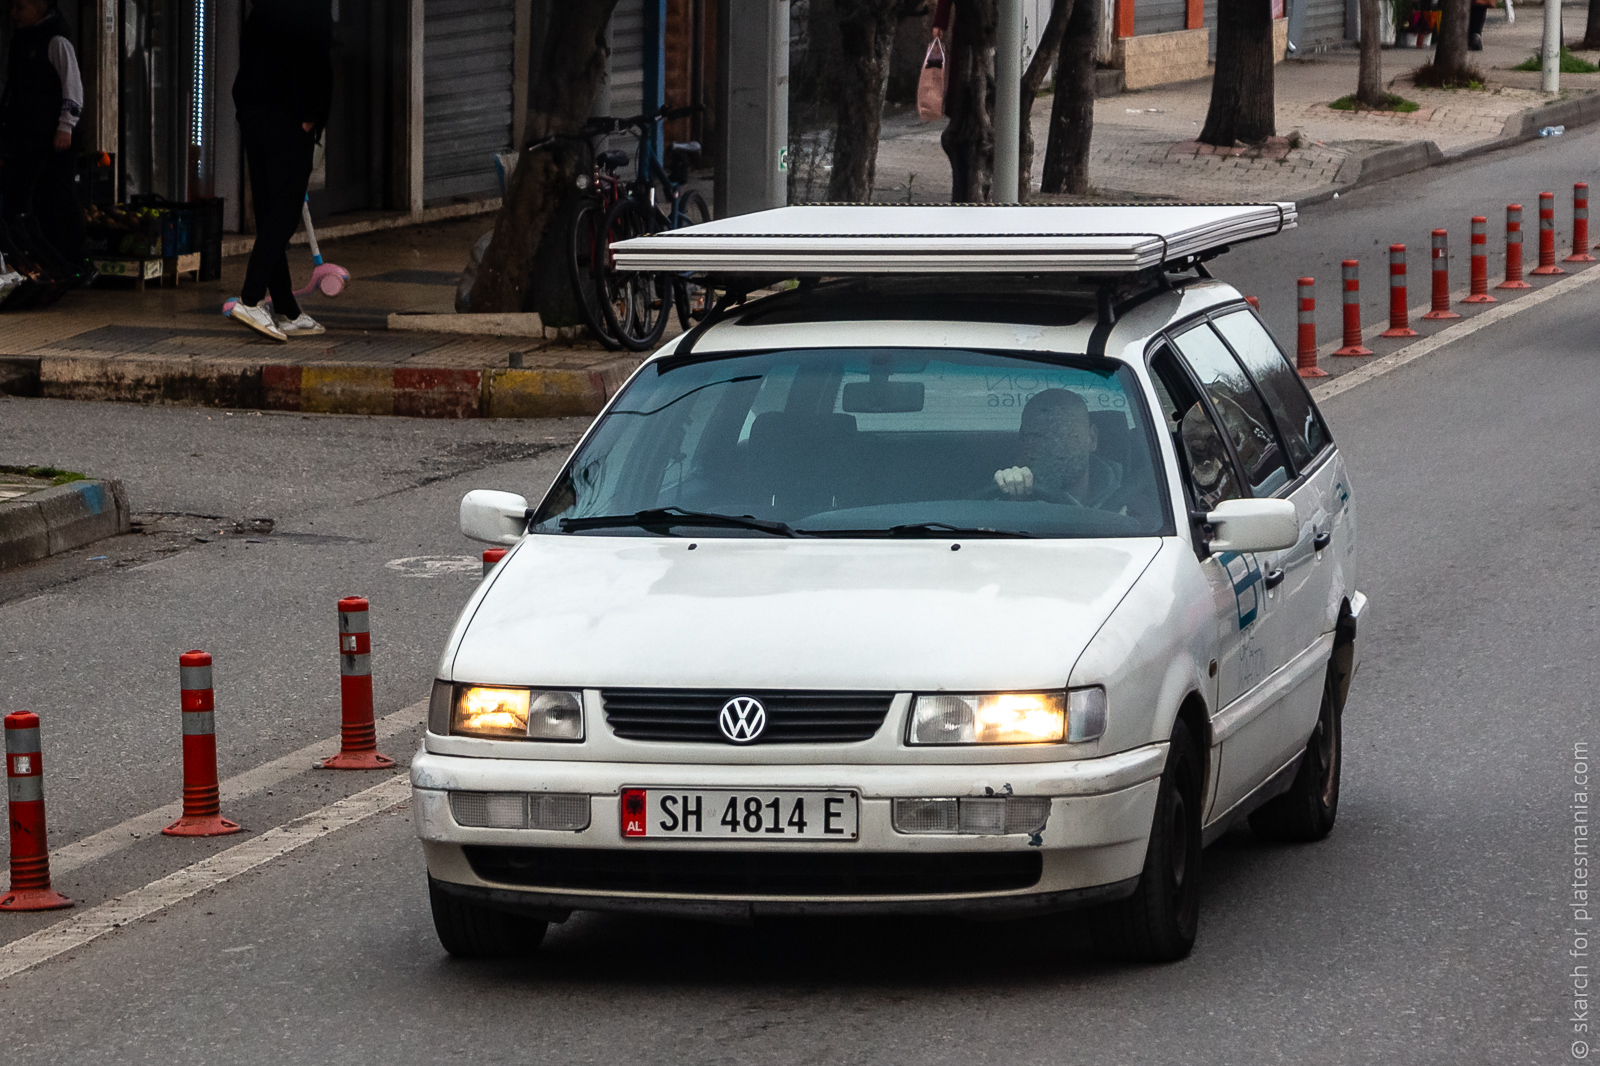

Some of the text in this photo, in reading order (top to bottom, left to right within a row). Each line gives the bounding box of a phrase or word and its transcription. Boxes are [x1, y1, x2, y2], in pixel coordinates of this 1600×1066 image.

[720, 697, 766, 742] VW
[626, 820, 643, 832] AL
[659, 795, 845, 834] SH 4814 E
